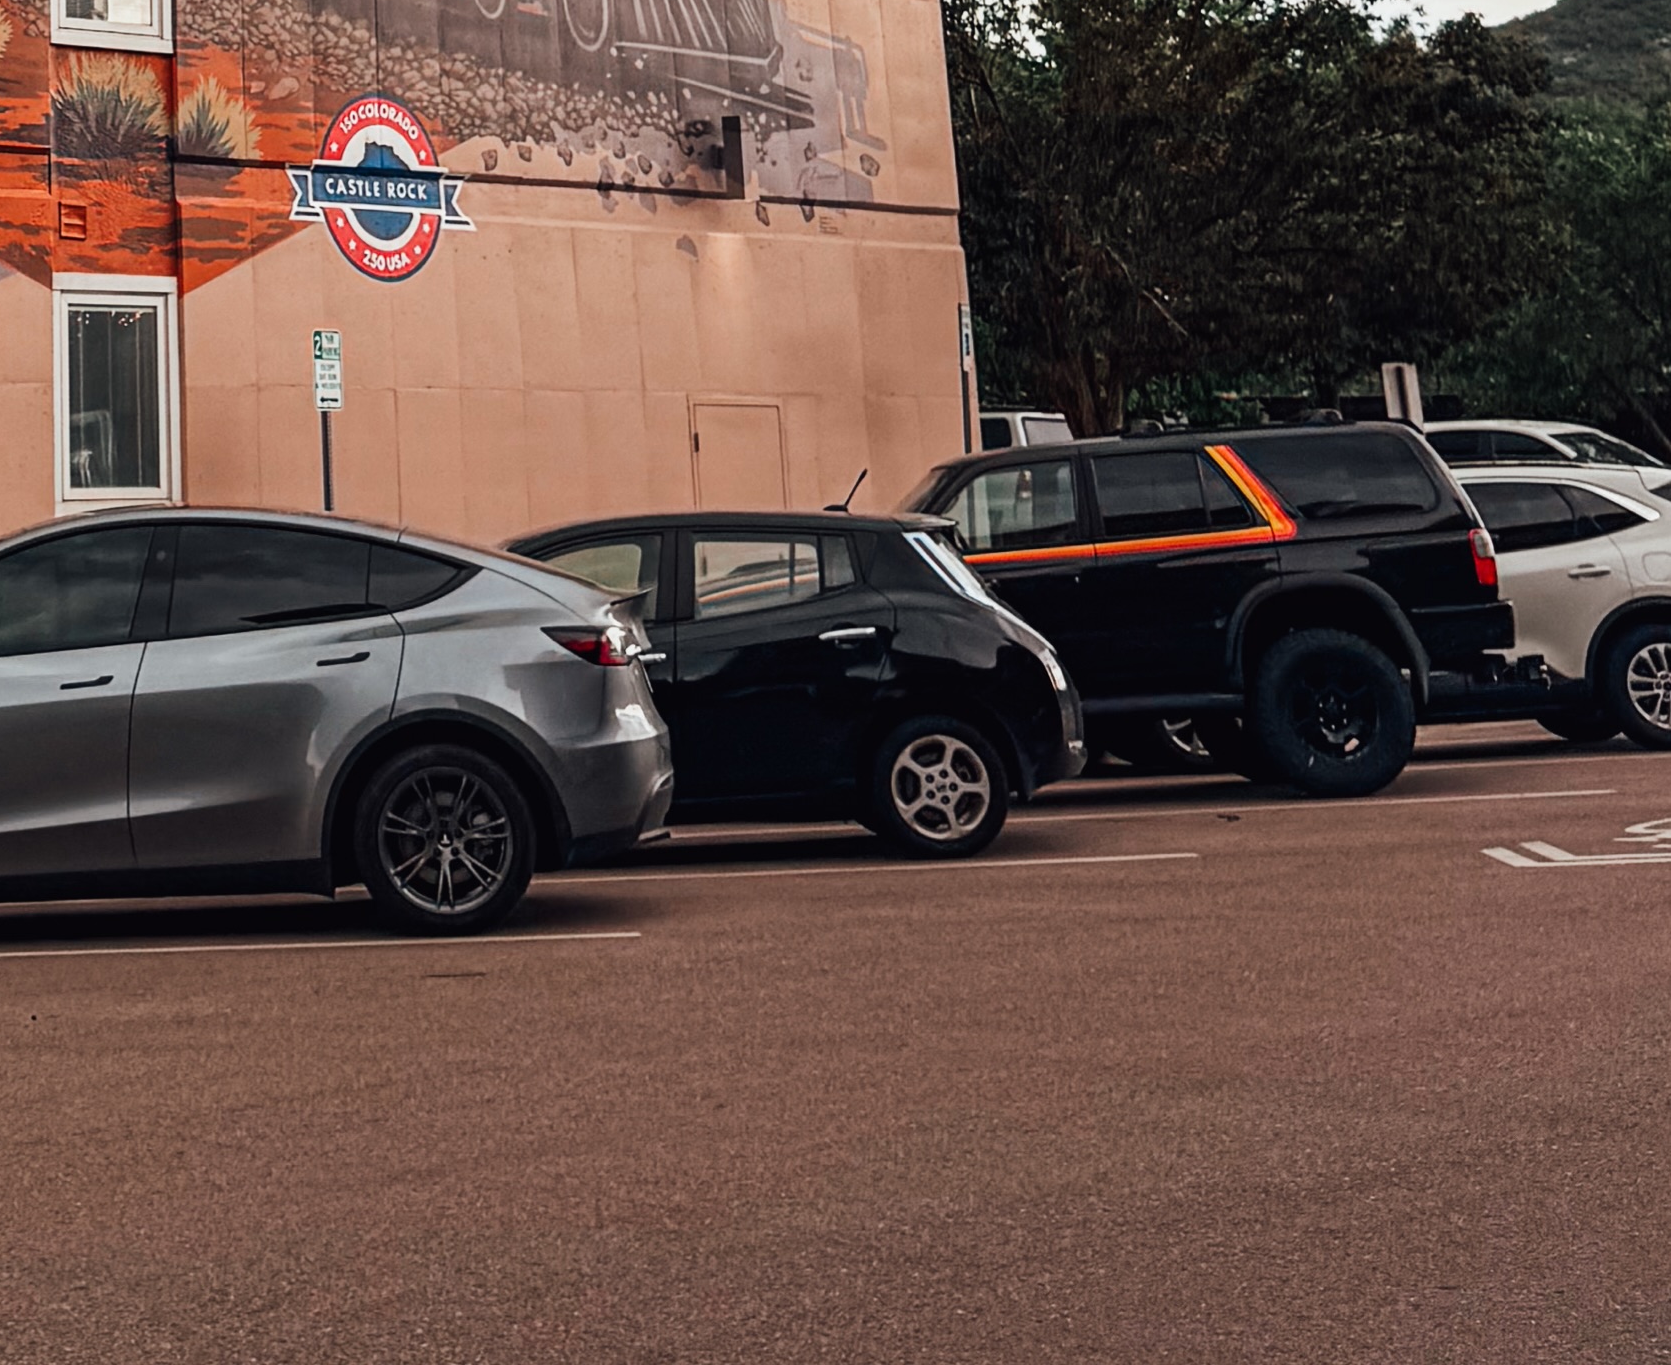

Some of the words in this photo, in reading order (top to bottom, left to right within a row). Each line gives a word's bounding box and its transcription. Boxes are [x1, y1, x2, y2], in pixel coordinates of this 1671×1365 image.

[339, 110, 359, 134] 150
[358, 102, 419, 140] COLORADO
[325, 177, 380, 197] CASTLE
[387, 182, 428, 200] ROCK
[362, 249, 386, 271] 250
[387, 252, 411, 271] USA
